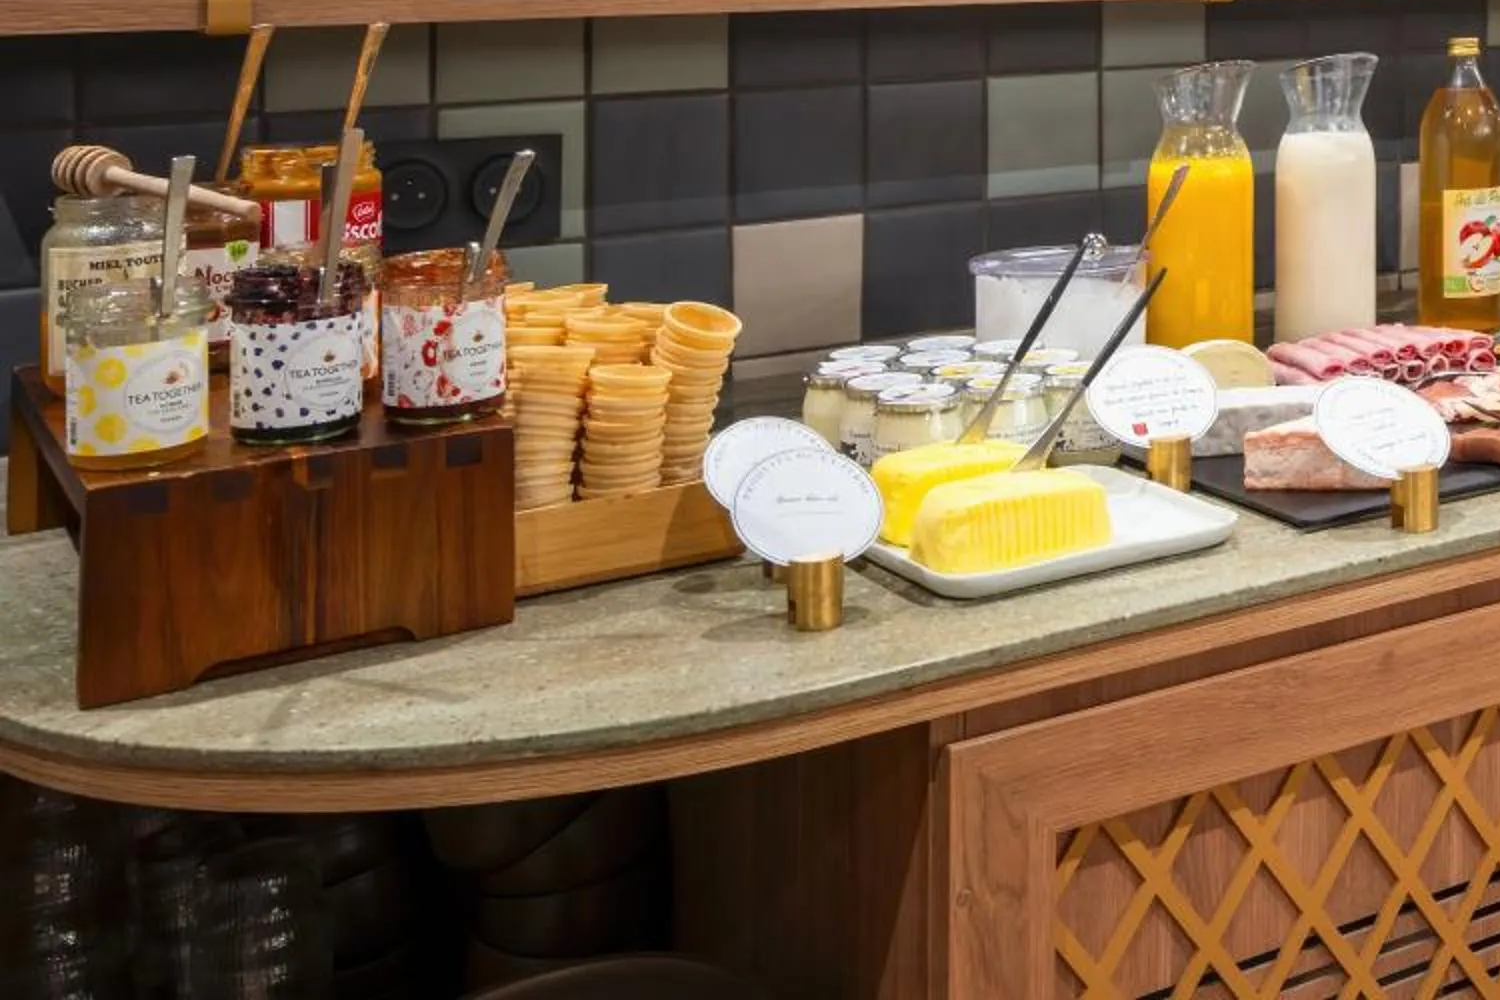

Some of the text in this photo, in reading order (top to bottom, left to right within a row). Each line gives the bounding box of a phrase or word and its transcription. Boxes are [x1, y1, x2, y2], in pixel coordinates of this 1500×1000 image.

[89, 258, 124, 271] MIEL
[289, 368, 311, 379] TEA
[127, 394, 152, 406] TEA
